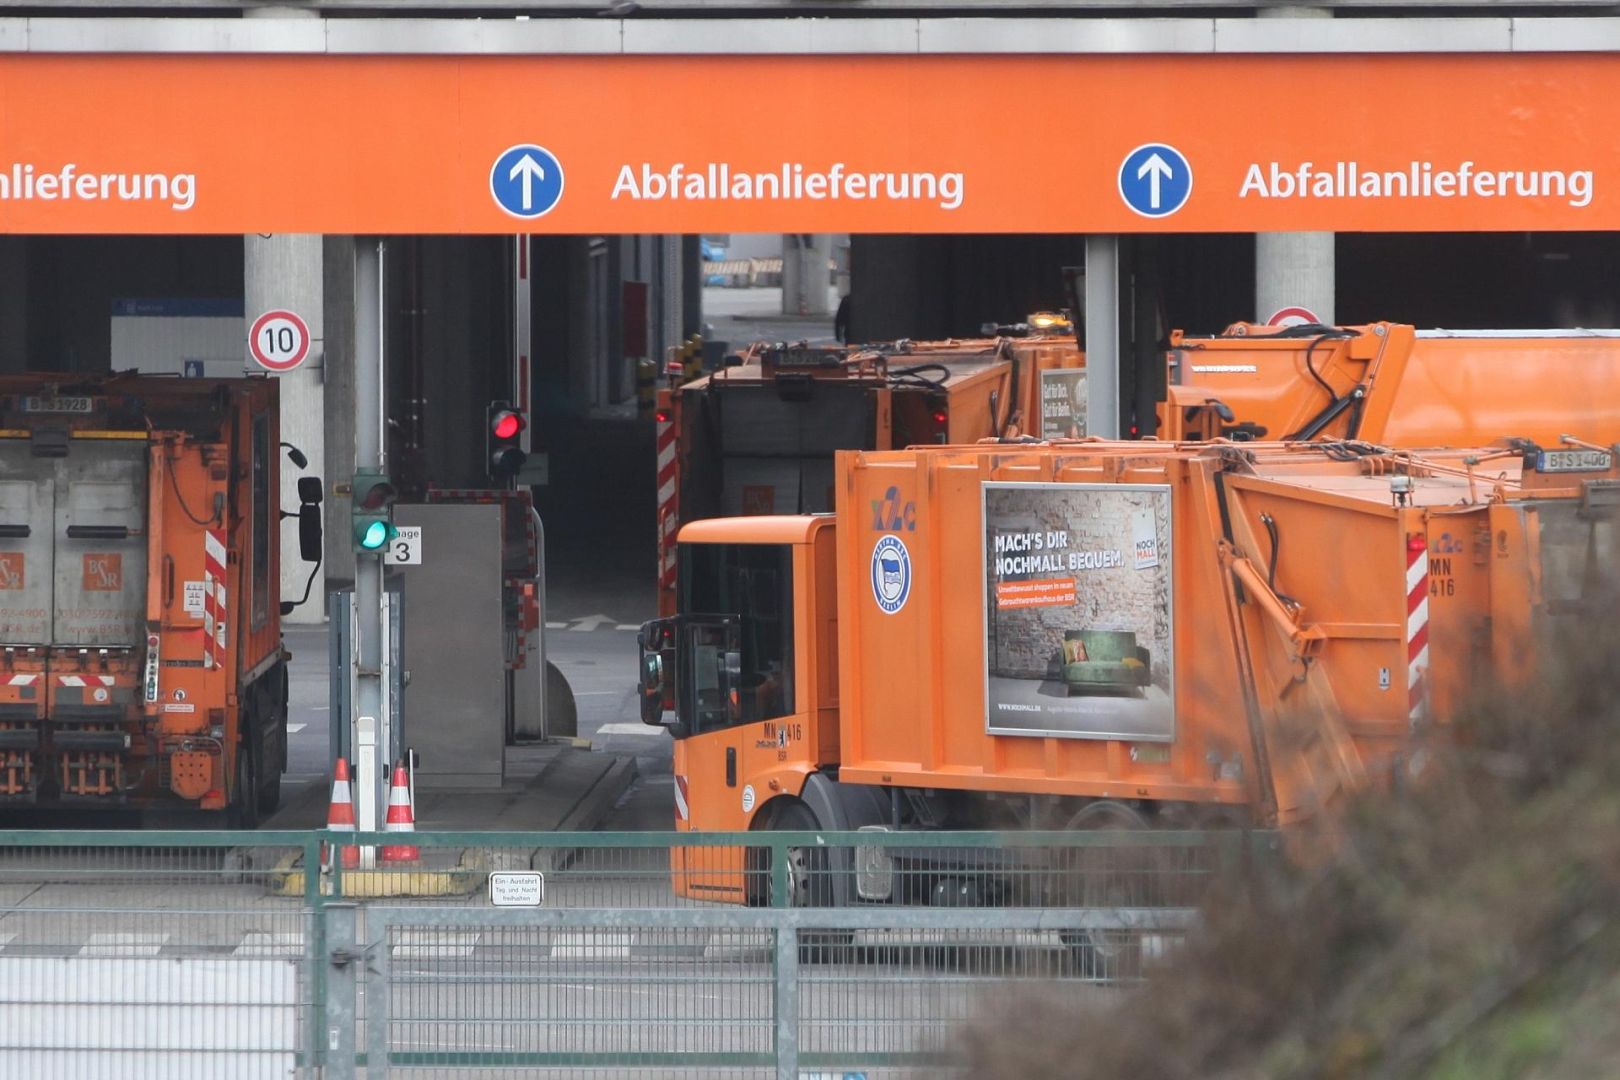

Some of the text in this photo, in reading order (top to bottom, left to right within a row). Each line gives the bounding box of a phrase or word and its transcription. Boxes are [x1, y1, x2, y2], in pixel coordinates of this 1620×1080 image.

[611, 163, 965, 209] Abfallanlieferung
[1239, 161, 1594, 207] Abfallanlieferung
[265, 327, 294, 353] 10
[1550, 454, 1558, 467] B
[399, 531, 420, 539] age
[995, 530, 1068, 553] MACH'S DIR
[1136, 538, 1155, 550] NOCH
[396, 542, 410, 562] 3
[996, 549, 1125, 576] NOCHMALL BEQUEM.
[1430, 559, 1451, 576] MN
[1430, 578, 1455, 597] 416
[764, 723, 776, 739] MN
